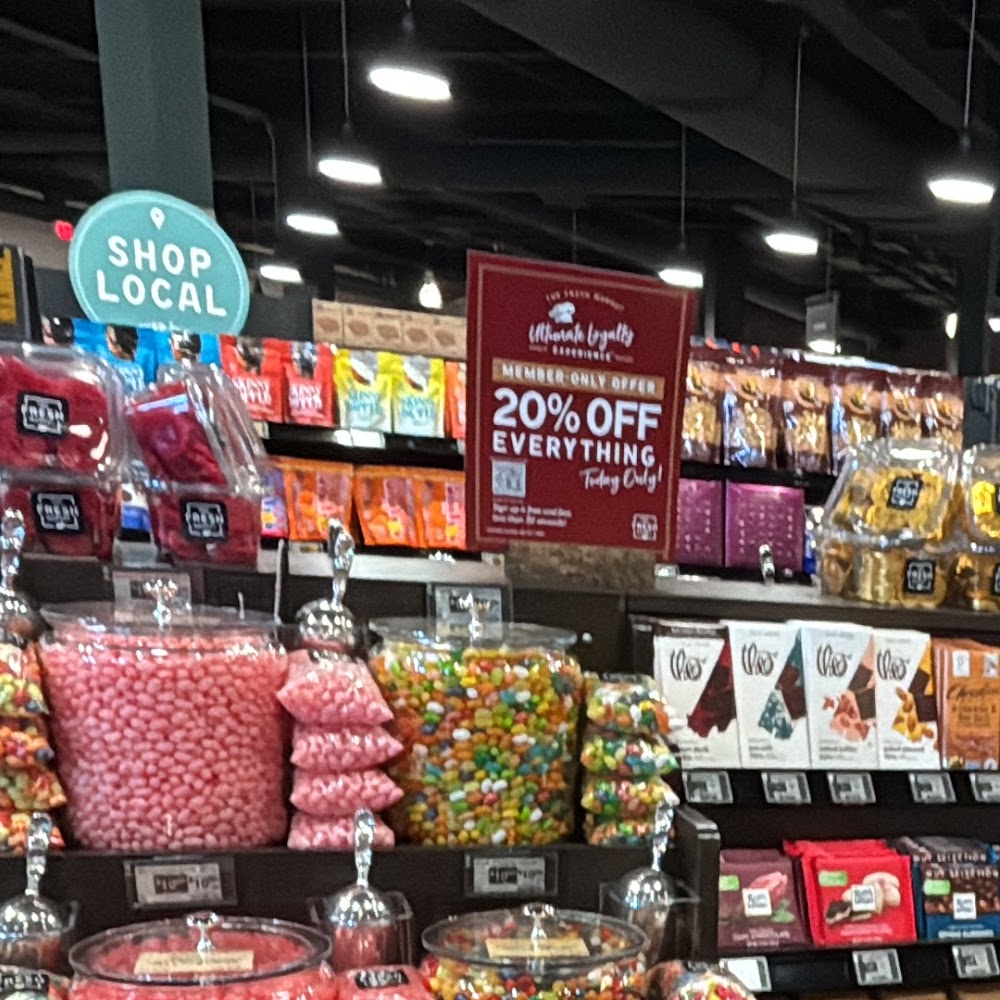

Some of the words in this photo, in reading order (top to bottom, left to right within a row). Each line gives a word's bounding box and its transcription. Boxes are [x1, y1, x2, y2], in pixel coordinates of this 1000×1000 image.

[107, 235, 212, 279] SHOP
[96, 269, 227, 317] LOCAL
[611, 375, 656, 395] OFFER
[493, 387, 580, 434] 20%
[586, 397, 662, 441] OFF
[492, 430, 656, 467] EVERYTHING
[579, 467, 620, 495] Today
[623, 464, 663, 494] Only!
